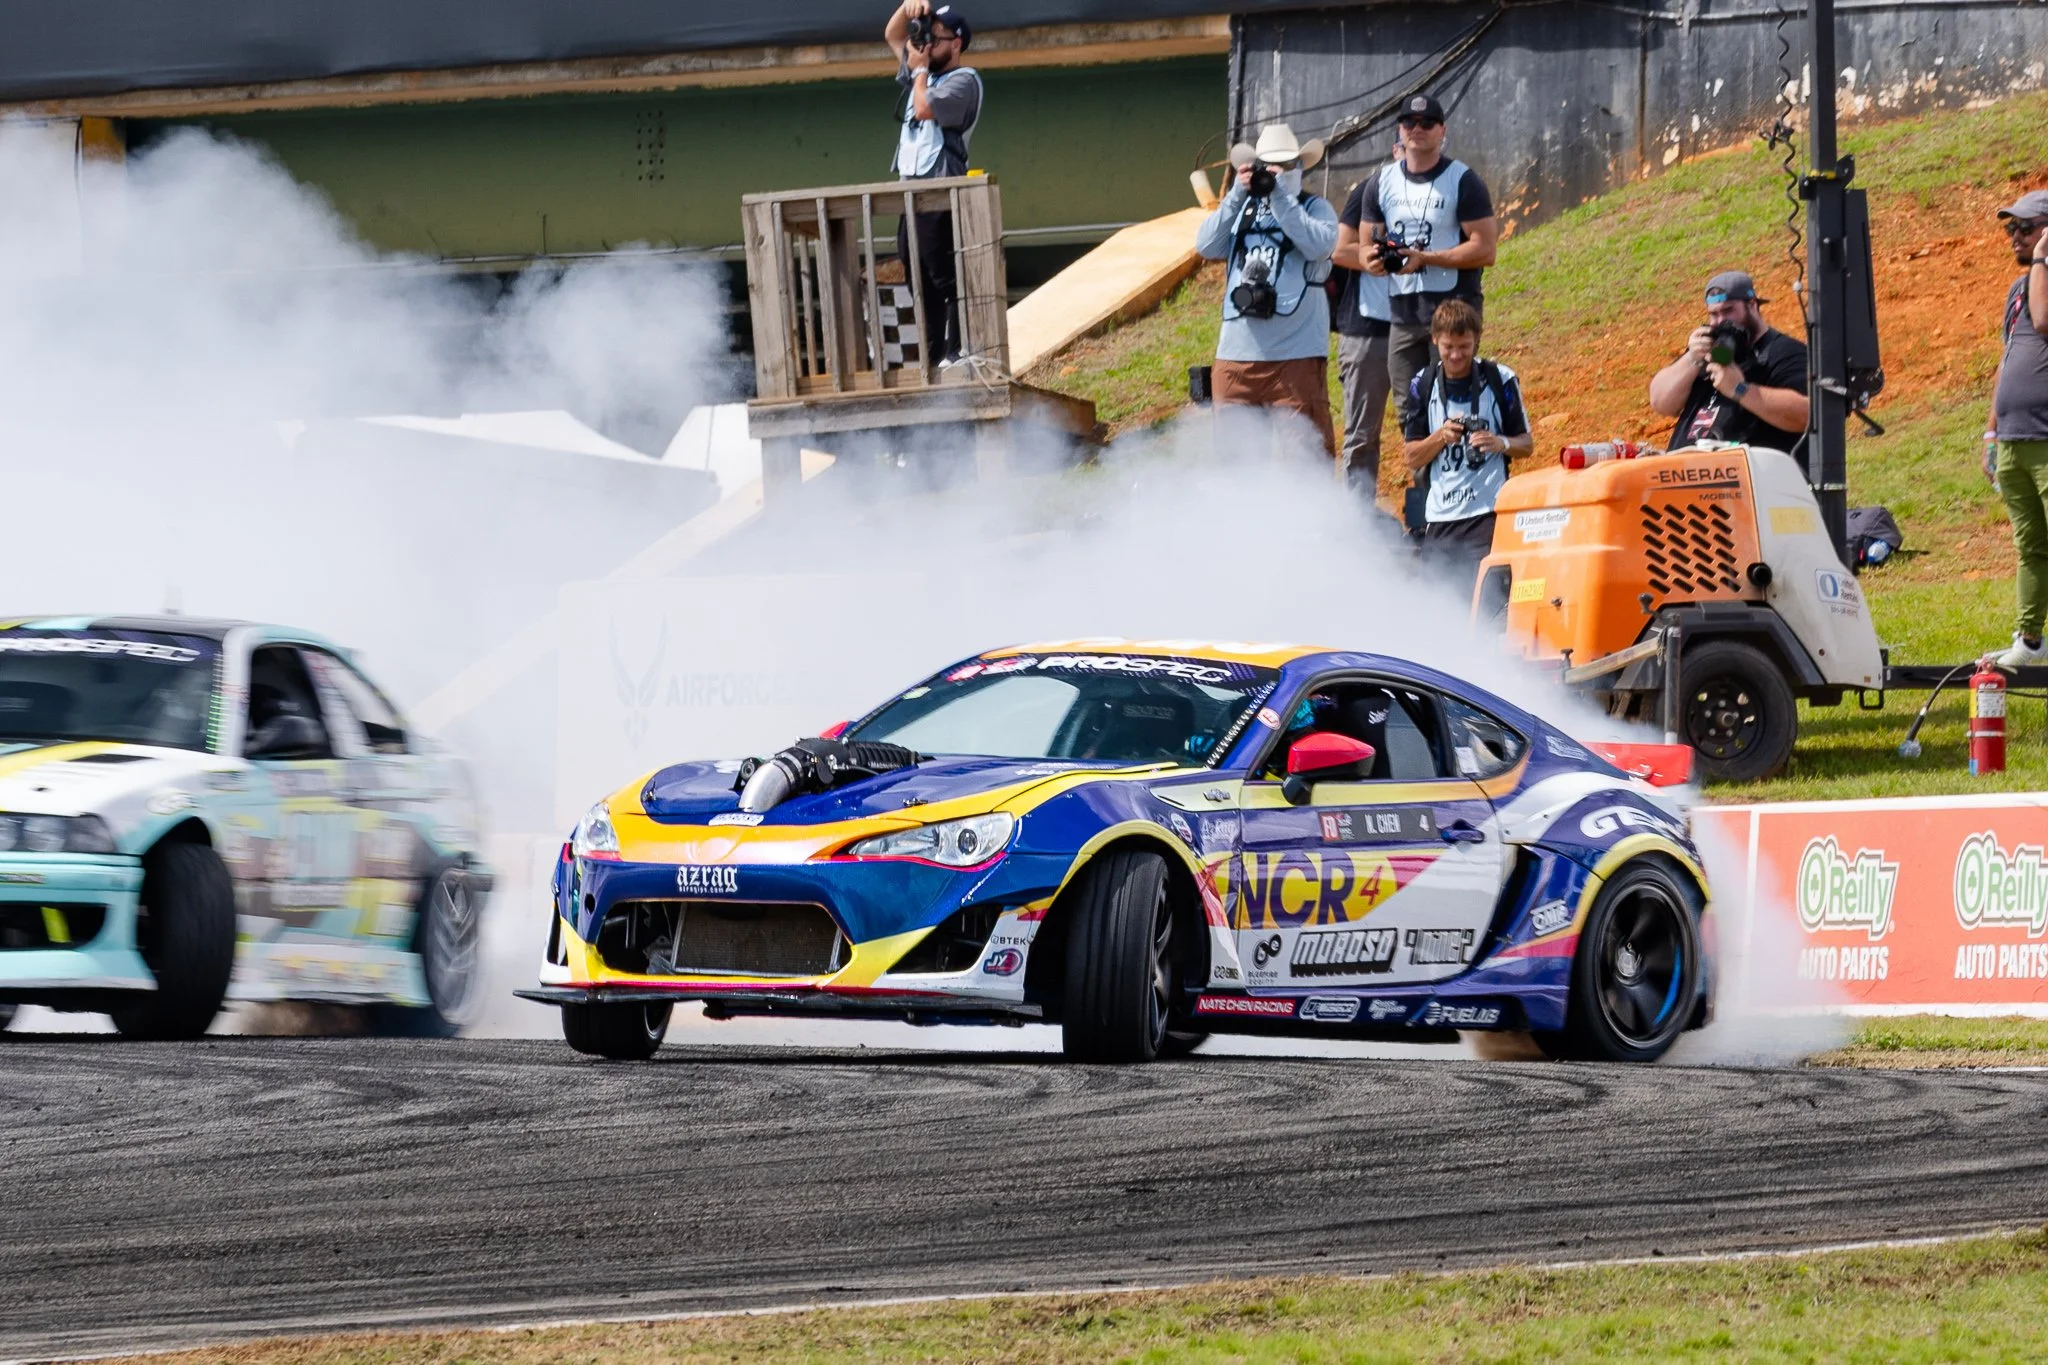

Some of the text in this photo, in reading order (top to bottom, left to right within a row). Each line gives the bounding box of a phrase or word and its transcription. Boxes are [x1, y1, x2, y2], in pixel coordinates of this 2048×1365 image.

[1650, 466, 1739, 483] ENERAC
[1443, 487, 1476, 505] MEDIA
[1699, 491, 1742, 501] MOBILE
[1037, 656, 1232, 682] PROSPEC
[1377, 813, 1401, 833] CHEN
[1419, 813, 1430, 832] 4
[677, 865, 739, 893] azrag
[1228, 850, 1384, 931] NCR 4
[1802, 849, 1892, 927] O'Reilly
[1959, 847, 2048, 924] O'Reilly
[1290, 928, 1398, 978] MOROSO
[1798, 945, 1890, 981] AUTO PARTS
[1954, 942, 2048, 980] AUTO PARTS
[1199, 998, 1226, 1012] NATE
[1226, 999, 1252, 1013] CHEN
[1252, 1000, 1294, 1014] RACING
